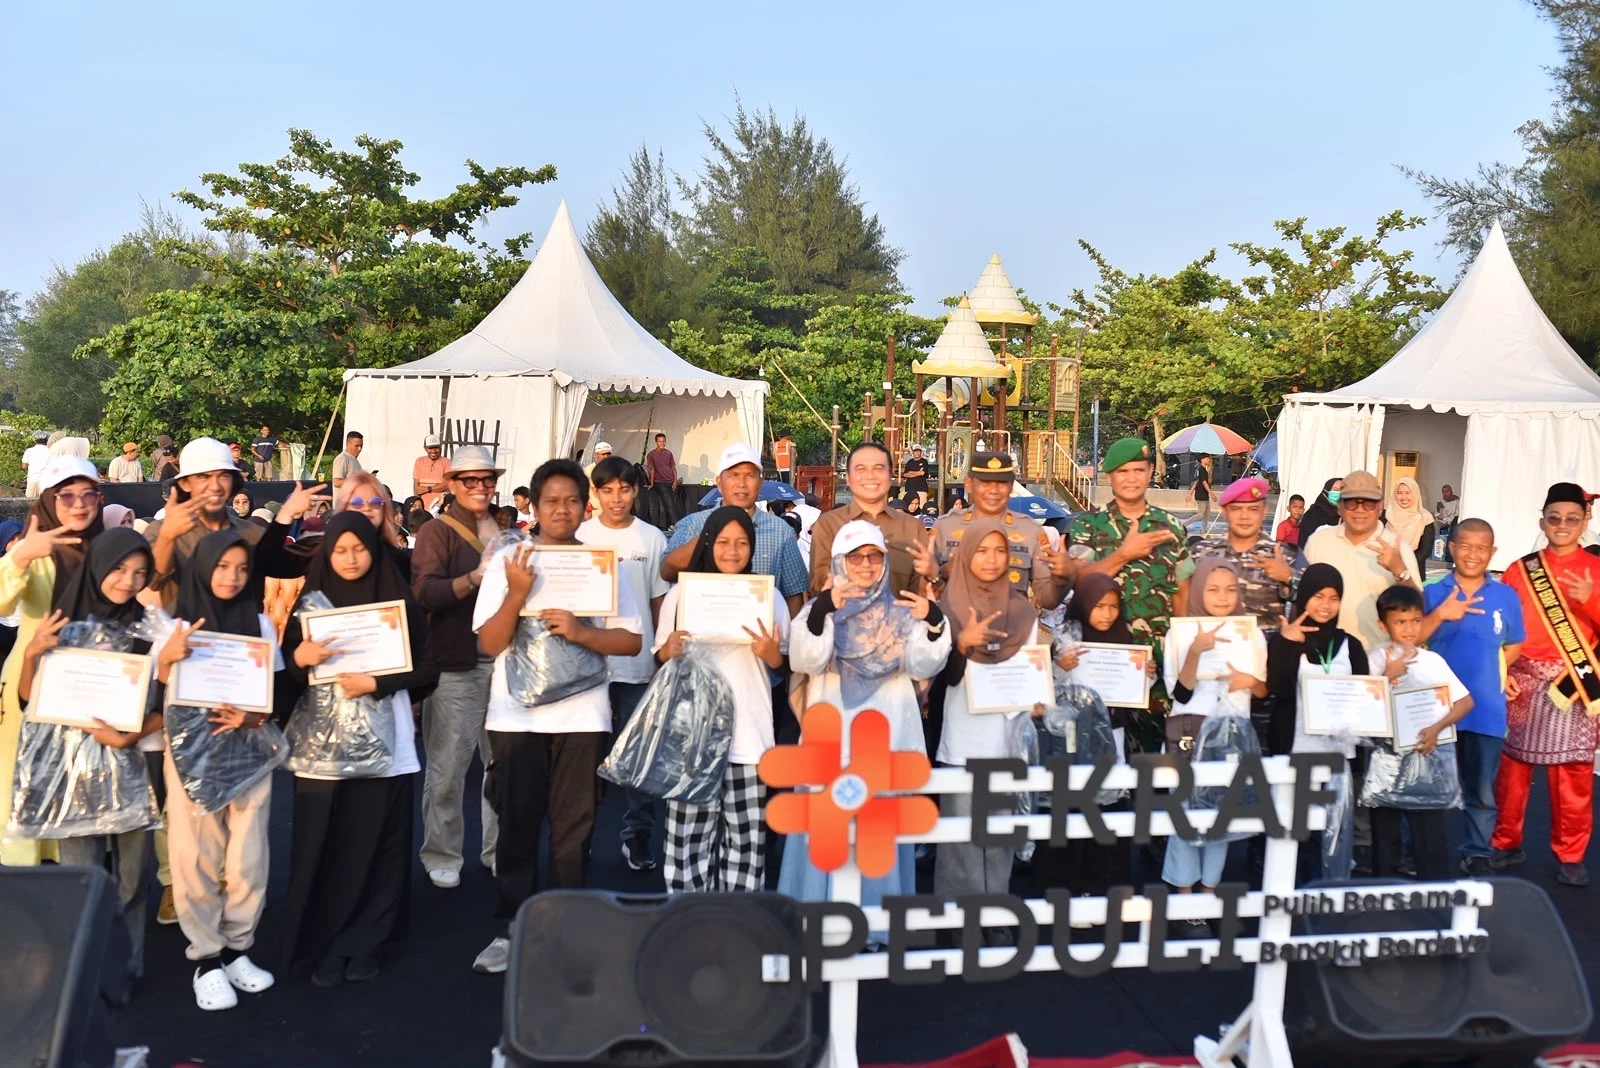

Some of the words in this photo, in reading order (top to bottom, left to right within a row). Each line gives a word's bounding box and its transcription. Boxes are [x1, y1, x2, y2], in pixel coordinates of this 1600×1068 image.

[1009, 545, 1029, 553] OLRI
[1547, 606, 1566, 625] KOTA
[1554, 621, 1581, 652] PARIAMAN
[966, 752, 1345, 848] EKRAF
[1264, 888, 1334, 918] Pulih
[1343, 889, 1479, 913] Bersama,
[799, 883, 1248, 994] PEDULI
[1259, 939, 1367, 965] Bangkit
[1378, 930, 1489, 958] Berdaya
